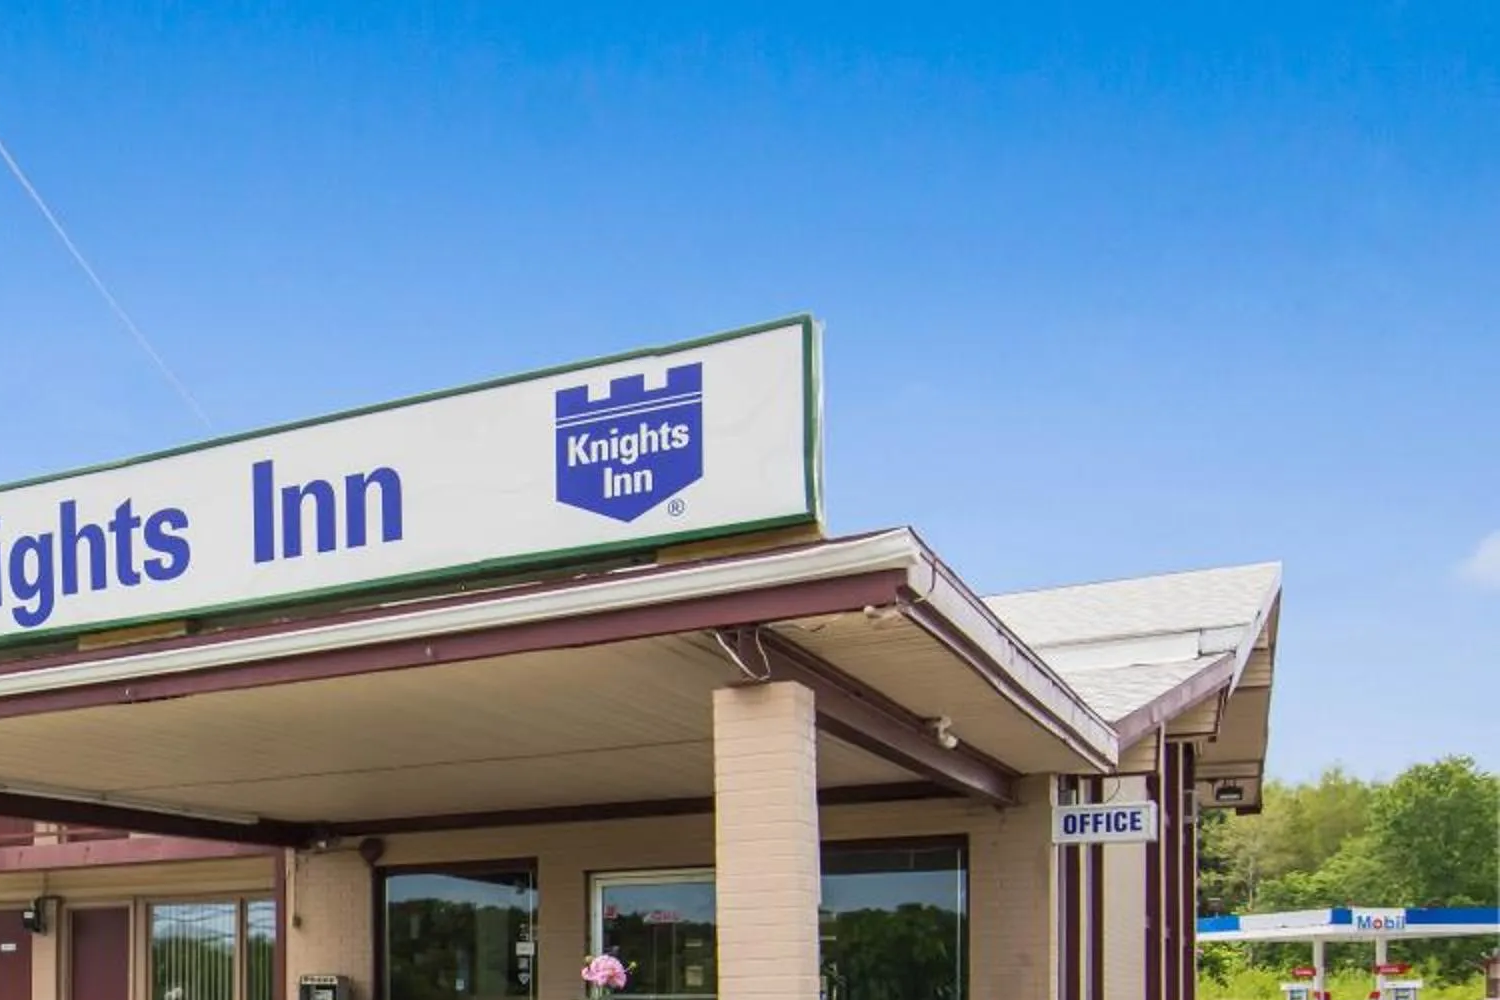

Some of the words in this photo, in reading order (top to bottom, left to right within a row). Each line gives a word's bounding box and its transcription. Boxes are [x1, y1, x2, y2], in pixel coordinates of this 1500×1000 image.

[567, 422, 690, 467] Knights
[603, 467, 653, 499] Inn
[252, 459, 403, 565] Inn
[1062, 811, 1143, 835] OFFICE
[1357, 915, 1405, 929] Mobil
